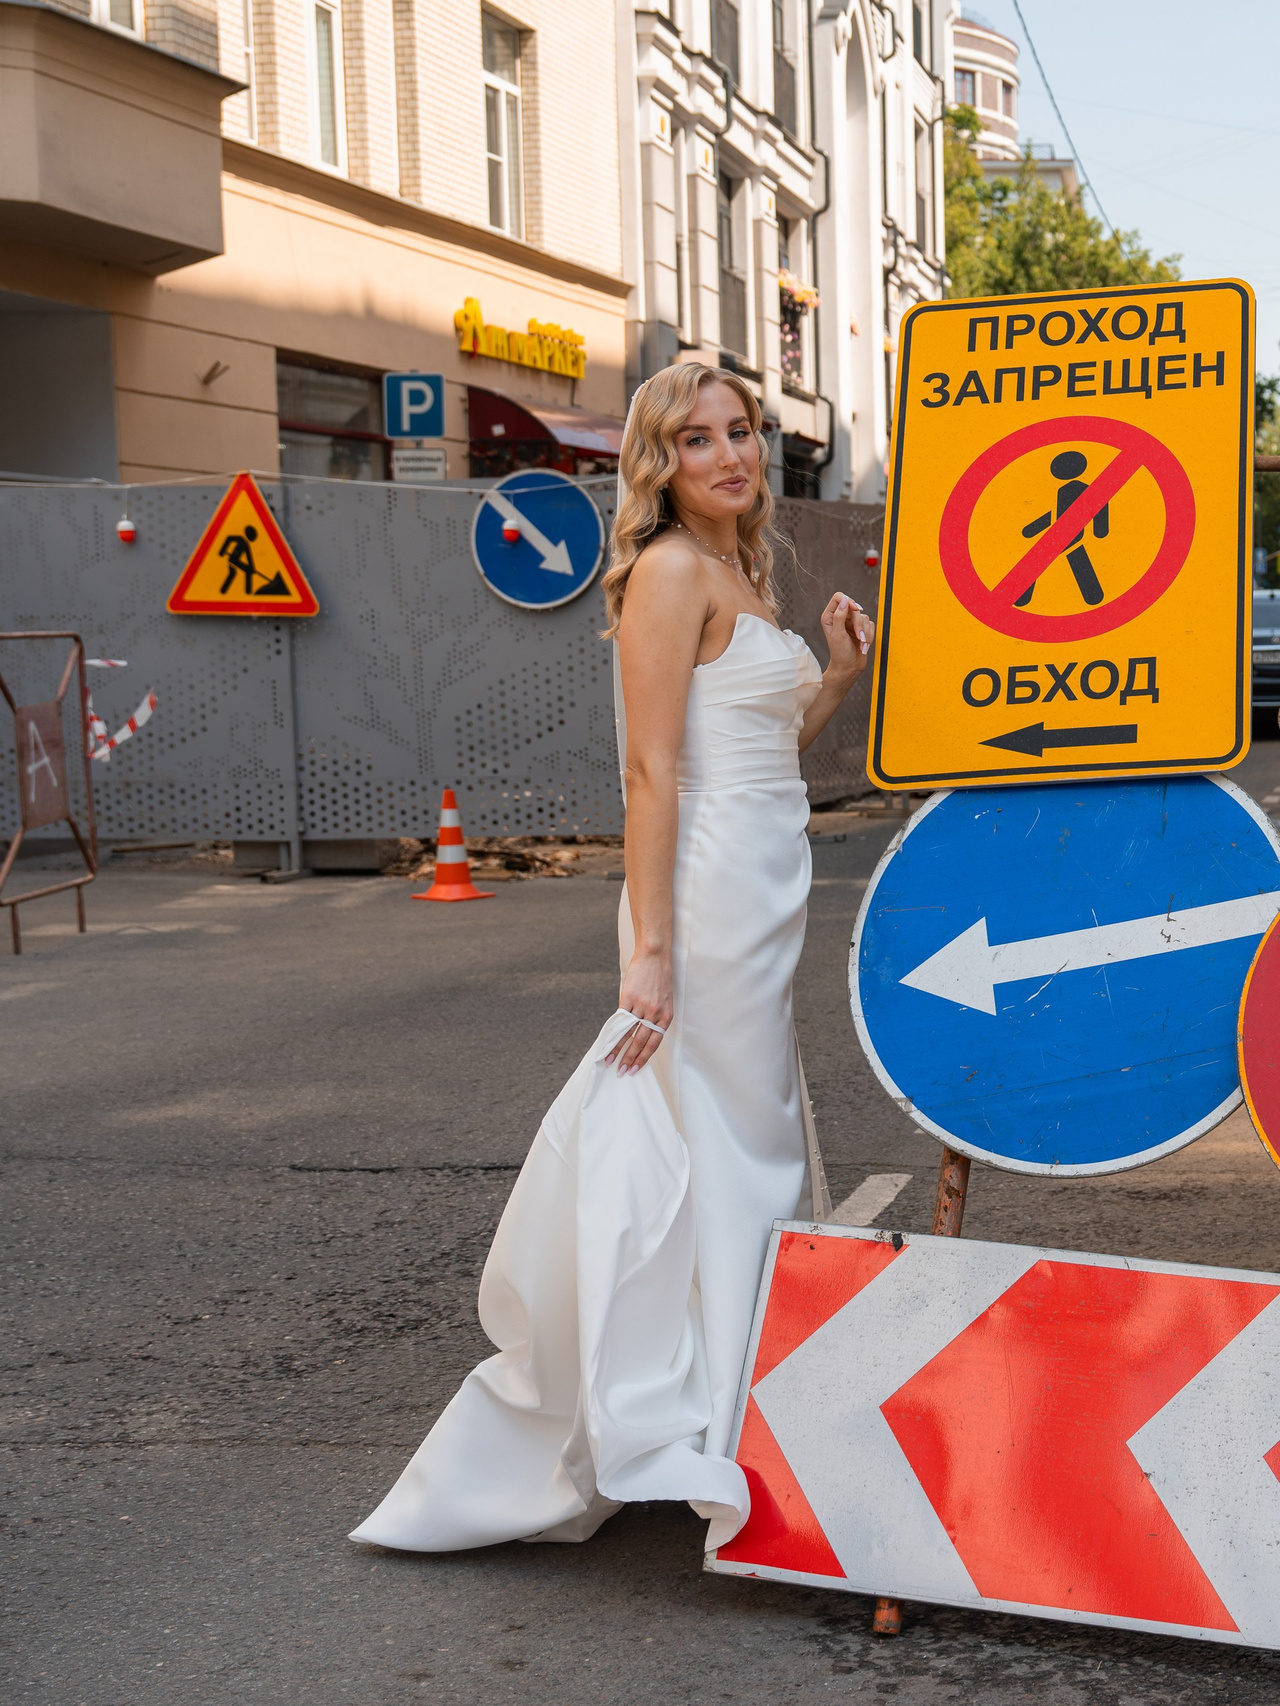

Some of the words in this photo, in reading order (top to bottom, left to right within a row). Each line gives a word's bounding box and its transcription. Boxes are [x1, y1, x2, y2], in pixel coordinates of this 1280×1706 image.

[967, 301, 1187, 353] ПРОХОД
[920, 350, 1225, 409] ЗАПРЕЩЕН
[401, 380, 434, 432] P
[961, 656, 1160, 708] ОБХОД
